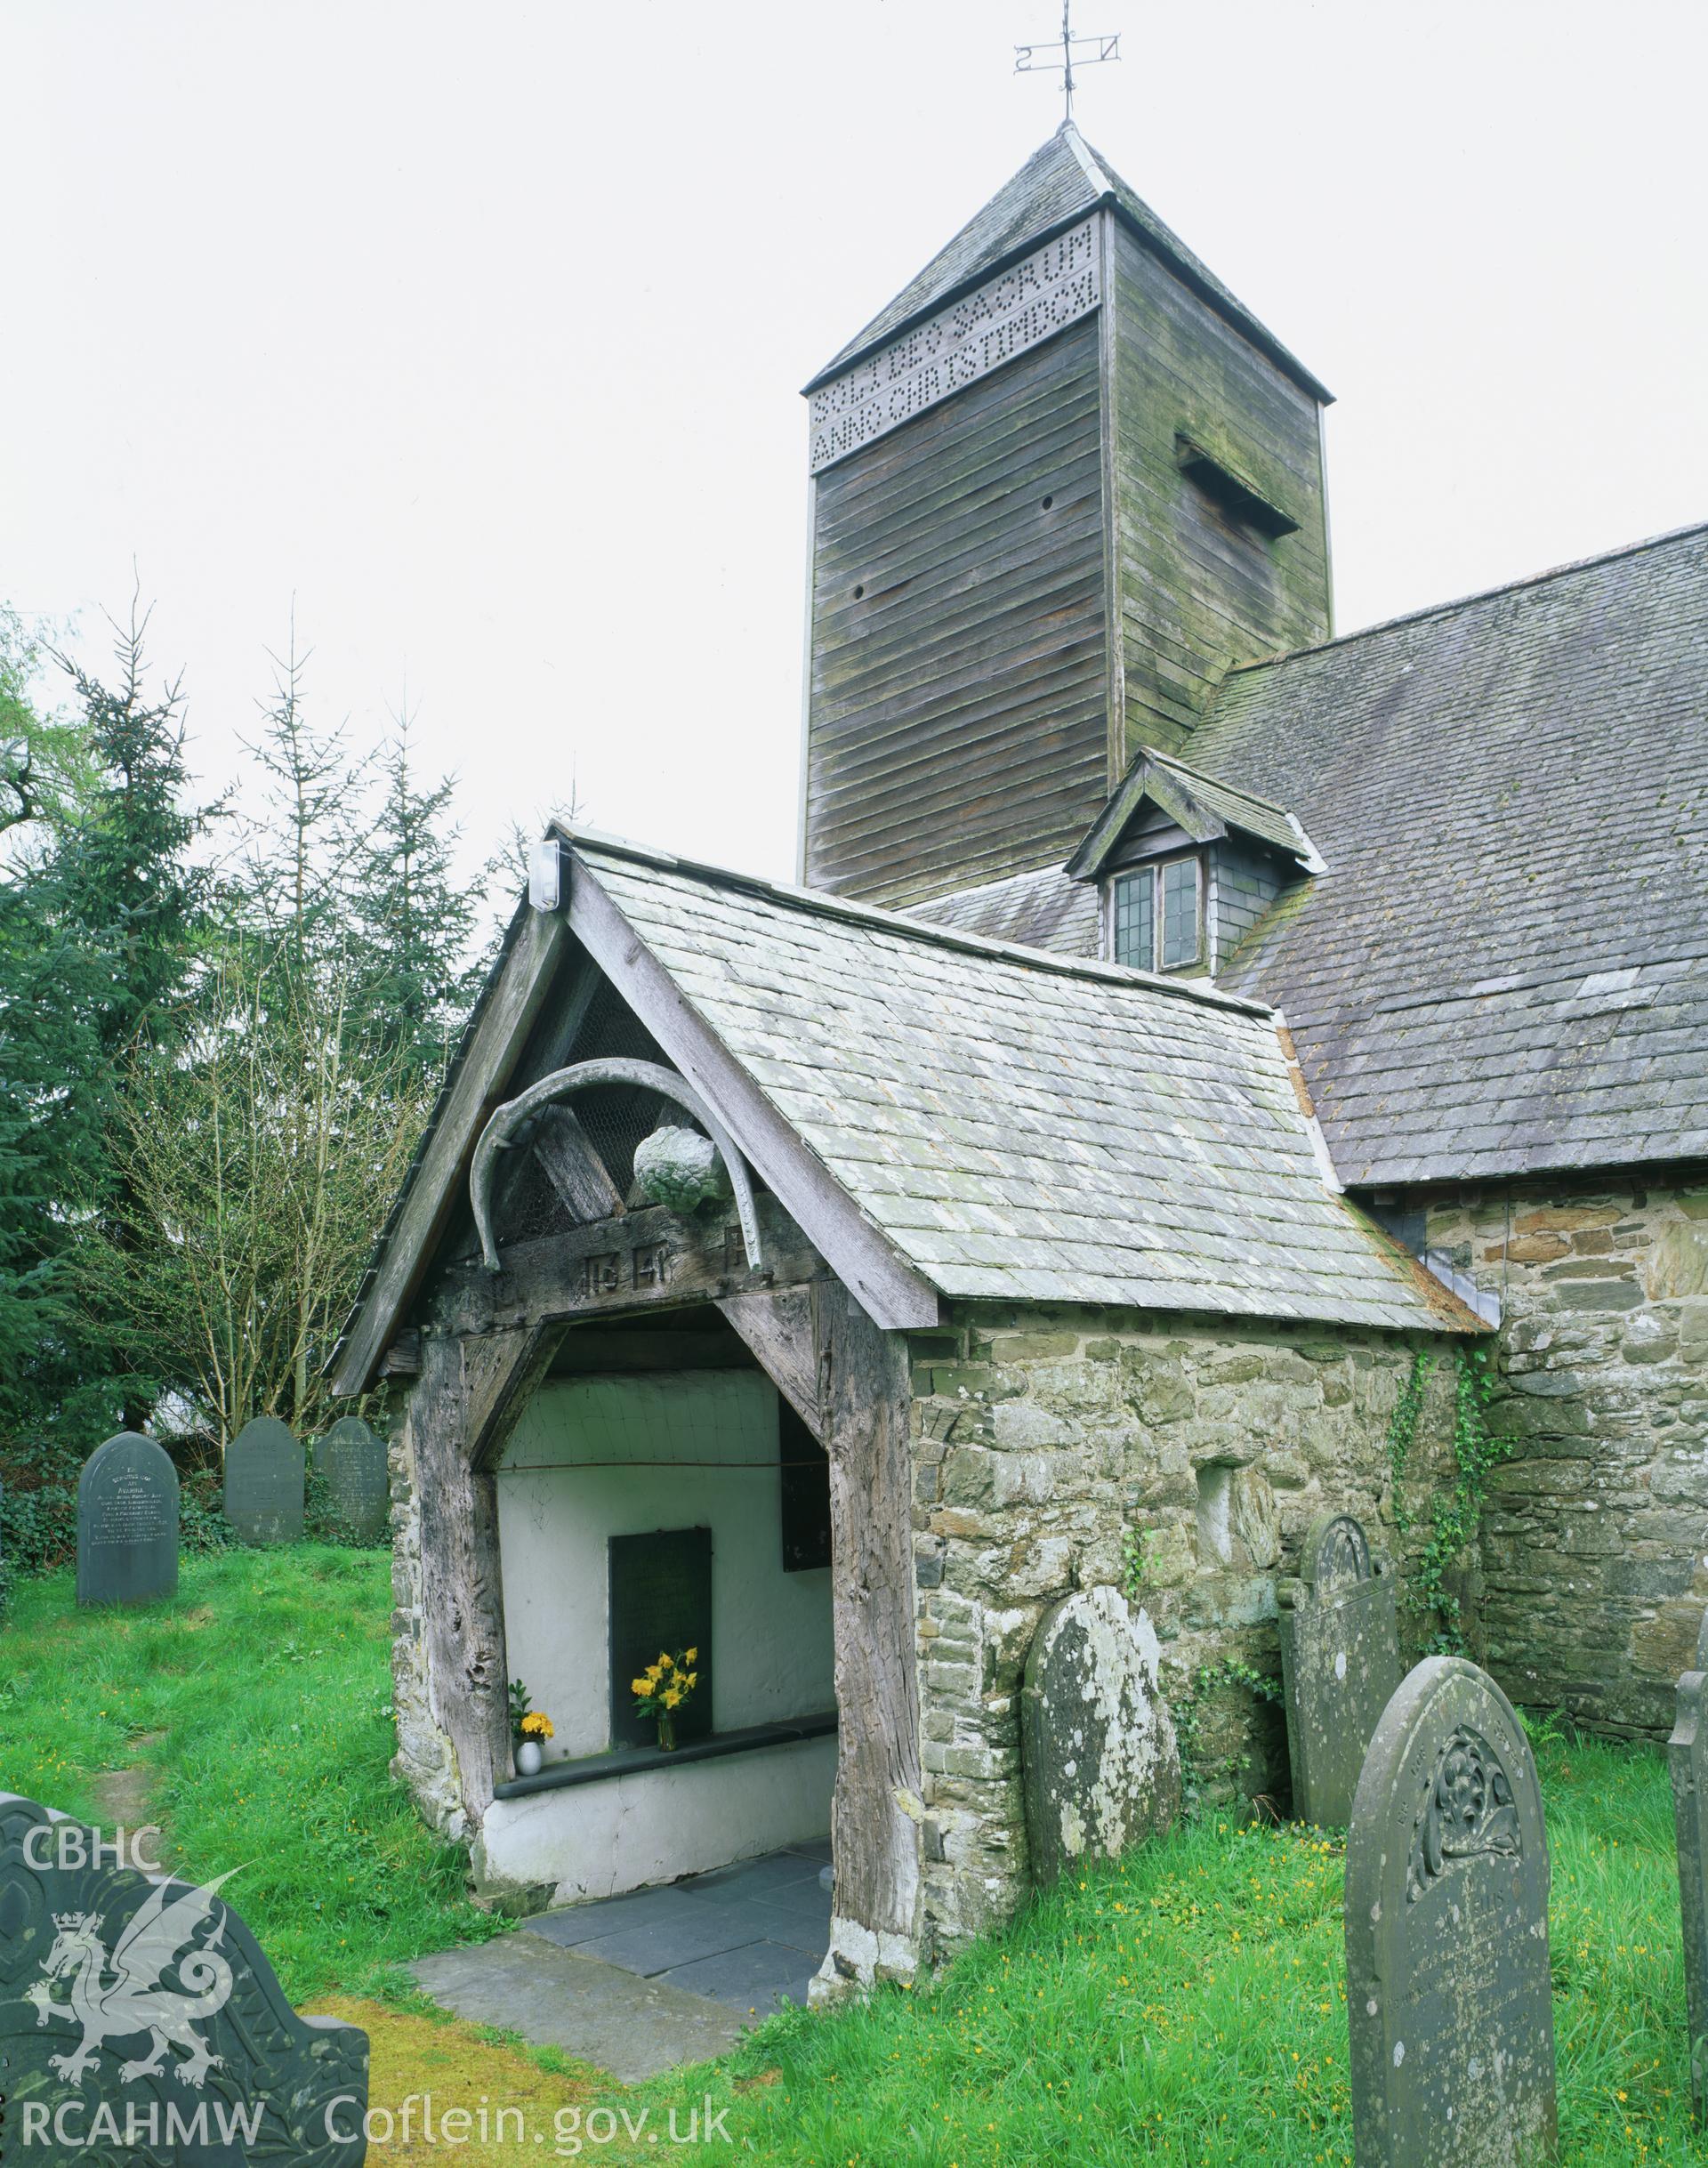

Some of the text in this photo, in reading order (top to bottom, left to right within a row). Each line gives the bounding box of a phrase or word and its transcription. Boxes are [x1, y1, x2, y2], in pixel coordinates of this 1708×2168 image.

[815, 224, 1092, 423] SOLI DEO SACRUM
[811, 402, 882, 469] ANNO
